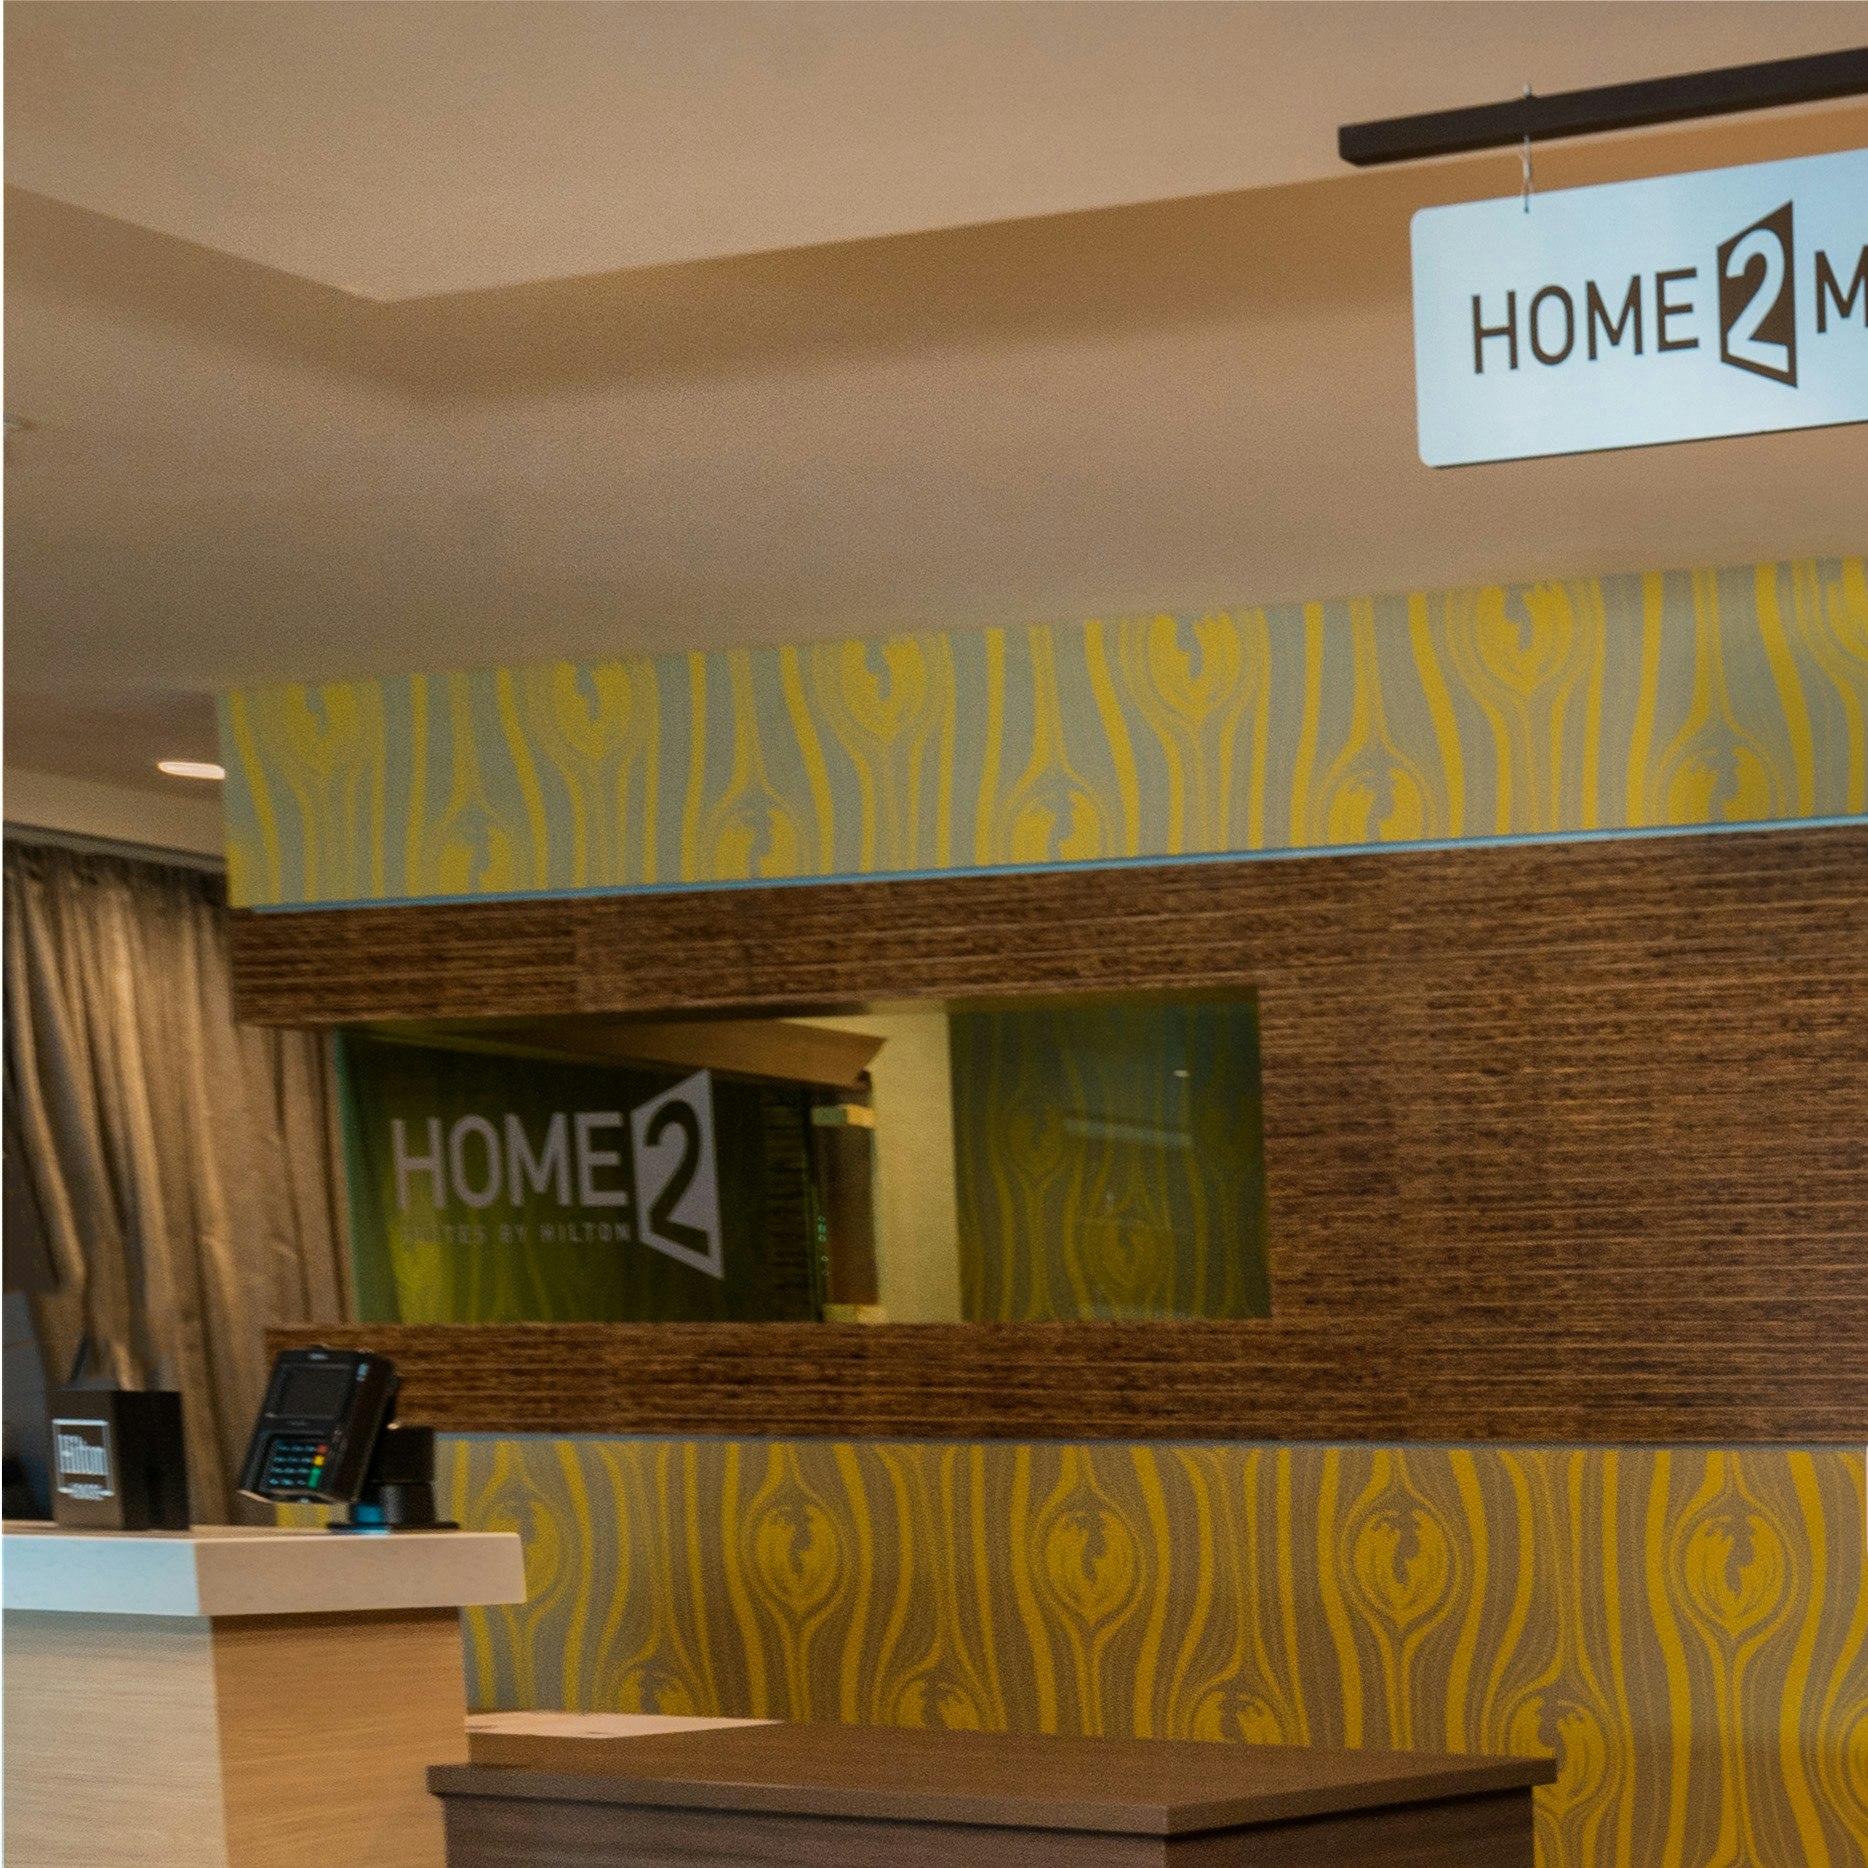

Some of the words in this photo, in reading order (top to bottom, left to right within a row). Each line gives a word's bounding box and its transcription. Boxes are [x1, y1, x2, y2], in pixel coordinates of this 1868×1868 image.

[1472, 267, 1699, 373] HOME
[1721, 214, 1794, 380] 2
[390, 1111, 629, 1209] HOME
[635, 1087, 718, 1268] 2
[500, 1224, 527, 1243] BY
[540, 1222, 632, 1242] HILTON
